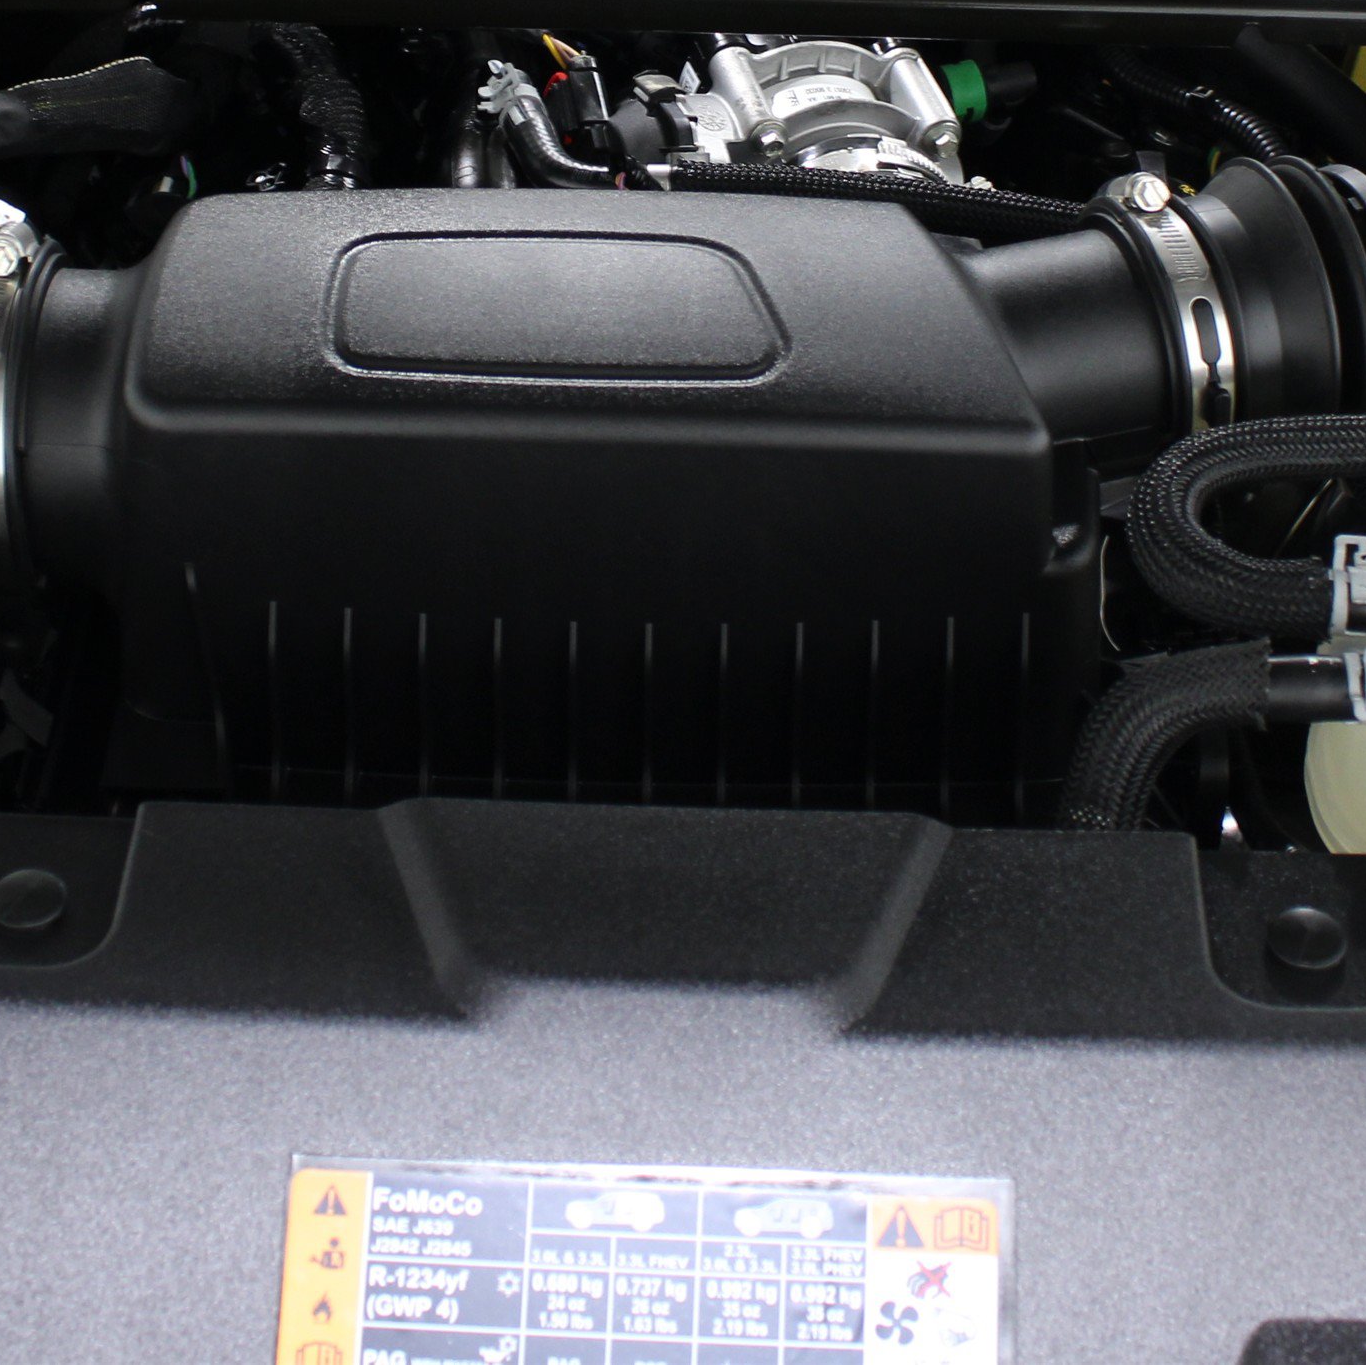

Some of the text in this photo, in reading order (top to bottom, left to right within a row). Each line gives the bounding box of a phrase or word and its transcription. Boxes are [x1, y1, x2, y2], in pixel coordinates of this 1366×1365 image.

[372, 1187, 483, 1216] FoMoCo
[372, 1216, 410, 1233] SAE
[368, 1264, 470, 1295] R-1234yf
[581, 1274, 603, 1299] kg
[615, 1276, 687, 1302] 0.737 kg
[706, 1280, 777, 1305] 0.992 kg
[790, 1284, 861, 1309] 0.992 kg
[366, 1293, 459, 1324] (GWP 4)
[547, 1294, 586, 1312] 24 oz
[651, 1301, 670, 1315] oz
[722, 1301, 761, 1318] 35 oz
[570, 1313, 594, 1330] lbs
[827, 1308, 845, 1323] oz
[654, 1317, 678, 1334] lbs
[745, 1320, 768, 1337] lbs
